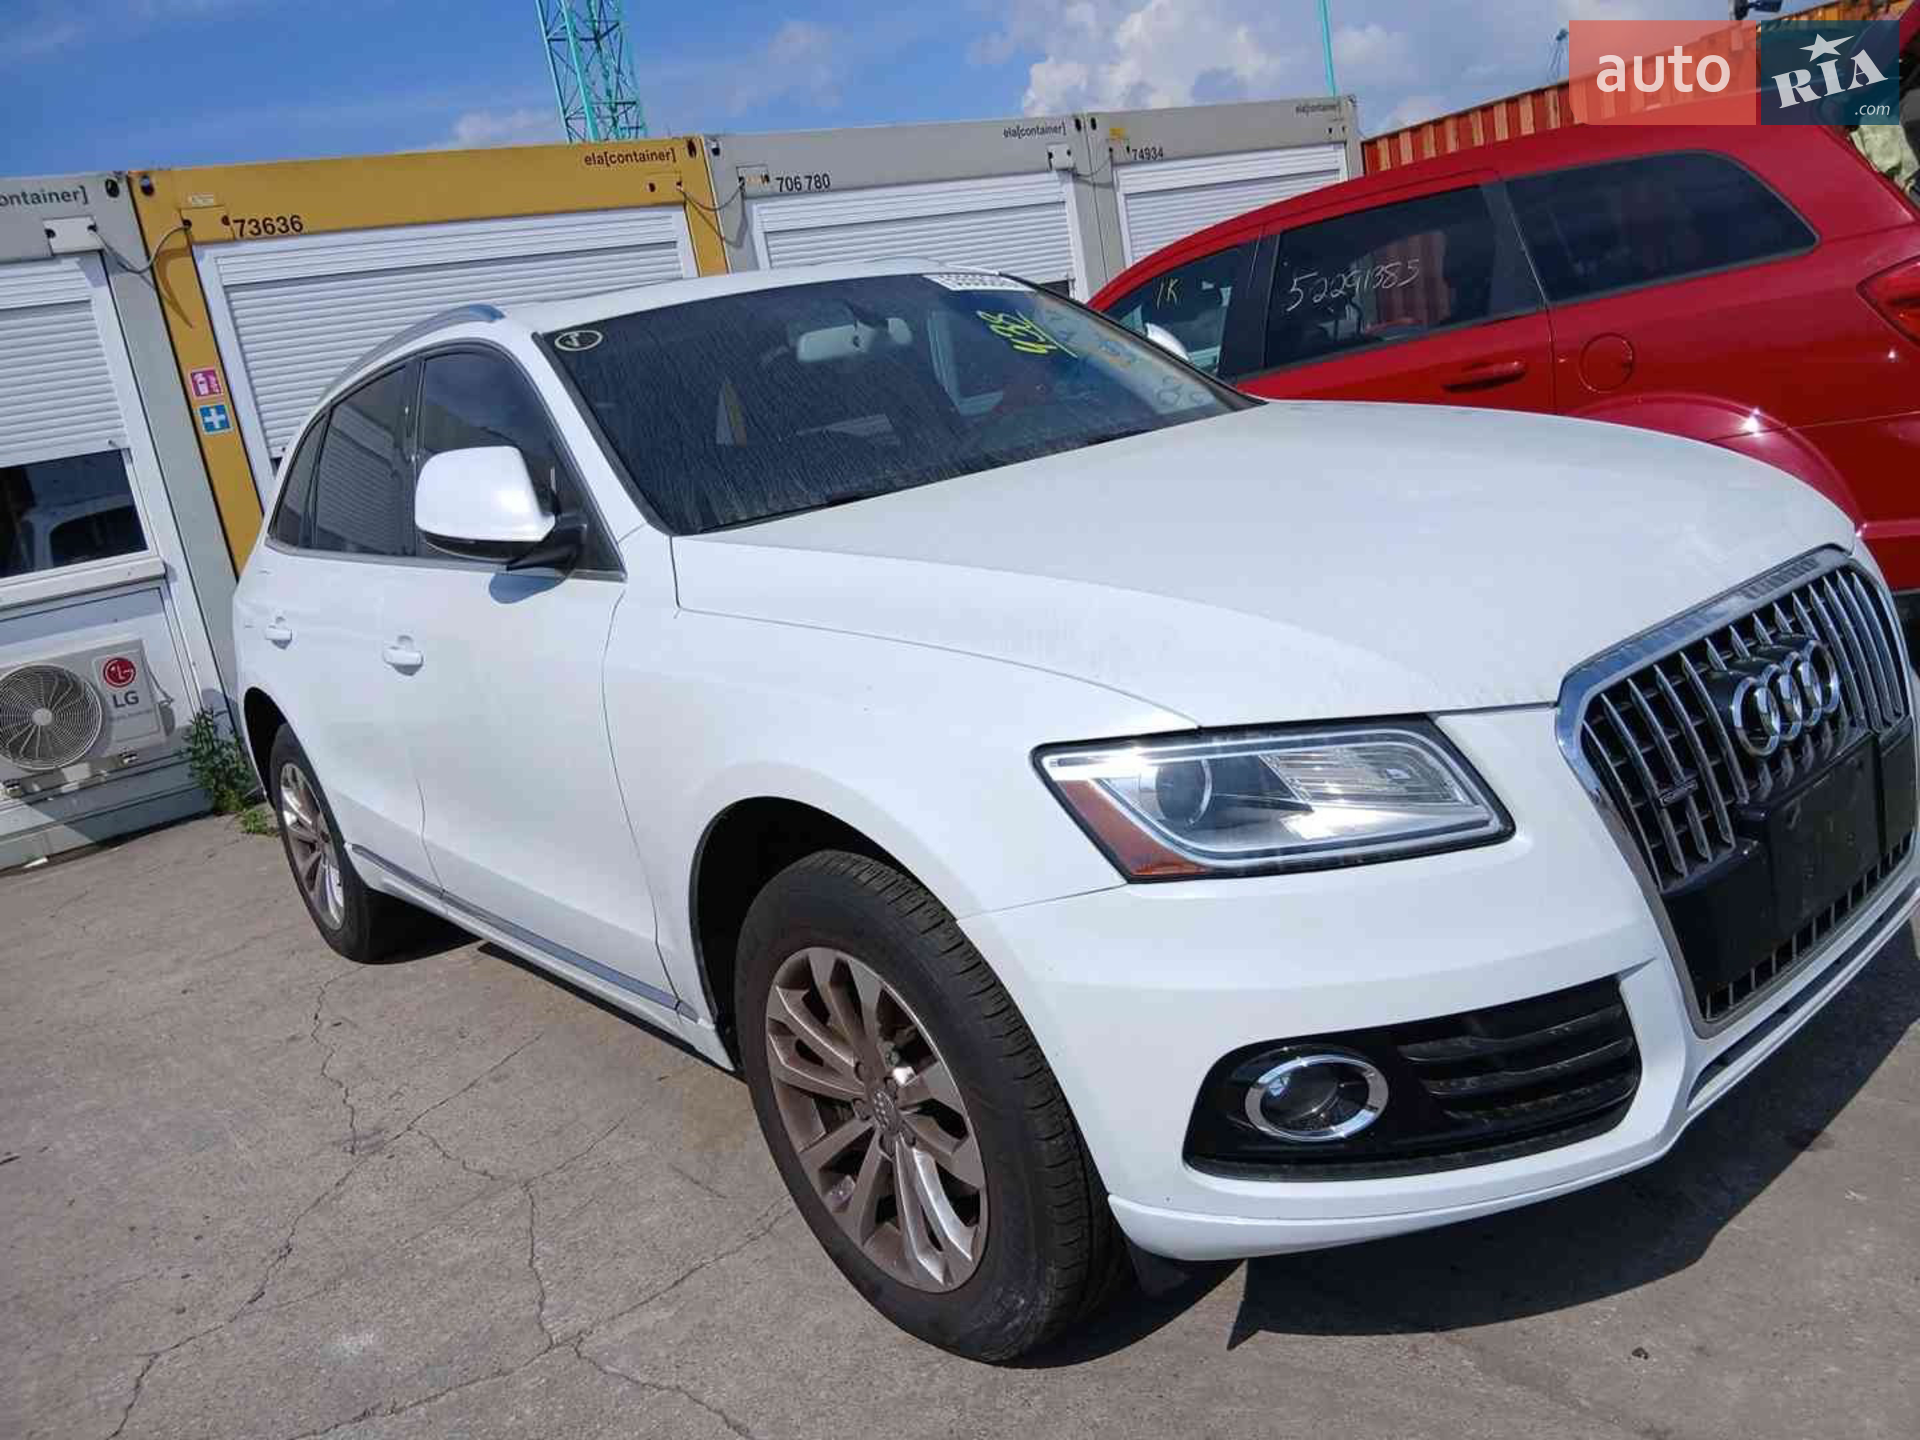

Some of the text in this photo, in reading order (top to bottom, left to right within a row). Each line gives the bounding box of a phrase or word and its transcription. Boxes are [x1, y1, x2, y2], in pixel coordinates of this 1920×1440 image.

[584, 147, 676, 166] ela[container]
[1131, 146, 1164, 161] 74934
[775, 172, 831, 192] 706 780
[232, 214, 304, 238] 73636
[112, 690, 140, 709] LG
